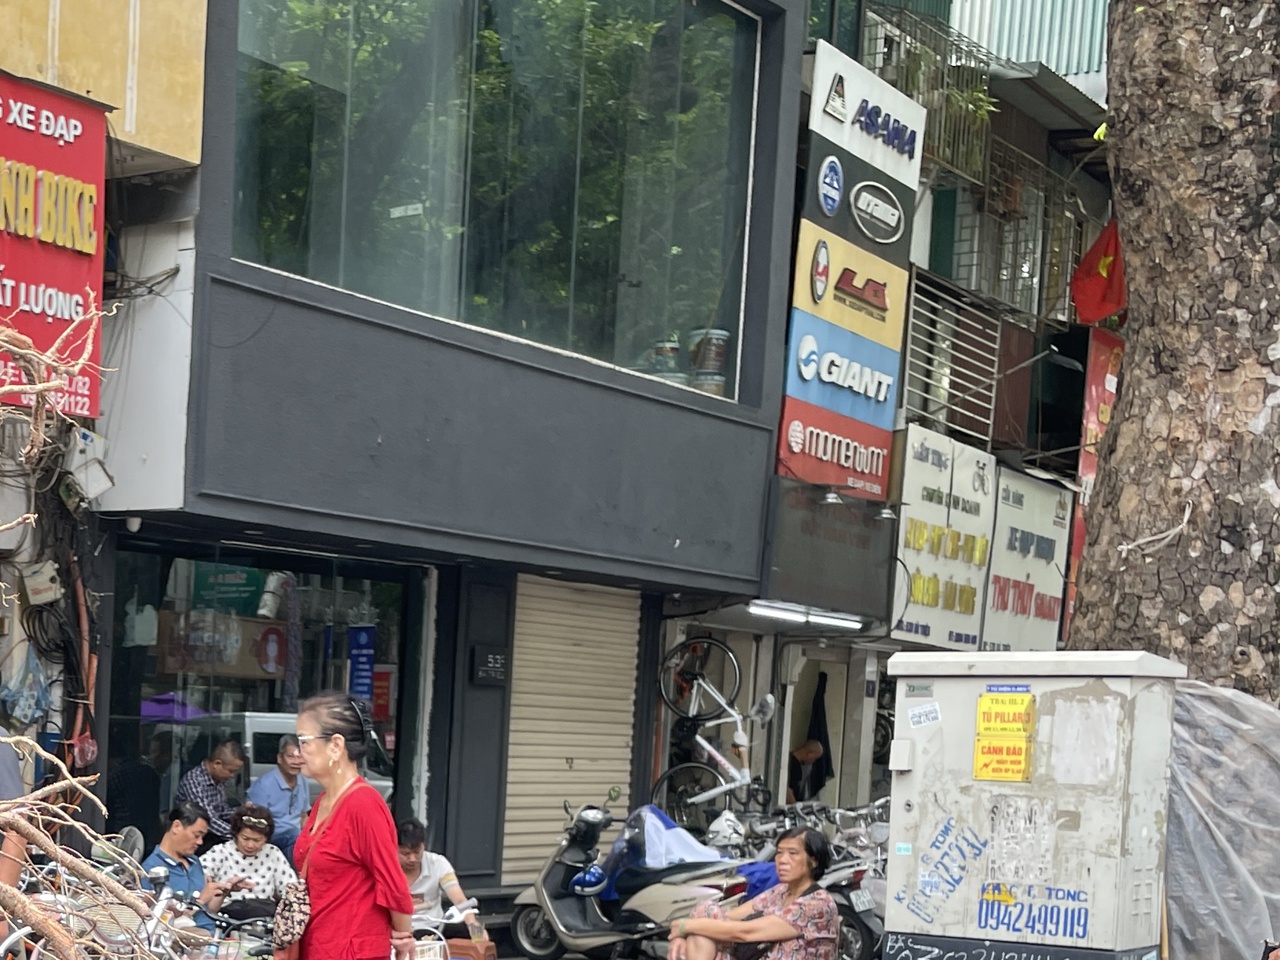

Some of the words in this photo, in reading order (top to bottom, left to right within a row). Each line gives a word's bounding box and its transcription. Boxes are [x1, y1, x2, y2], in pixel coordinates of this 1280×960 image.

[6, 98, 37, 132] XE
[38, 109, 84, 148] ĐẠP
[37, 169, 98, 256] BIKE
[19, 281, 85, 324] LƯỢNG
[819, 351, 893, 402] GIANT
[804, 425, 883, 477] momentum
[994, 711, 1023, 724] PILLAR
[978, 898, 1089, 939] 0942499119
